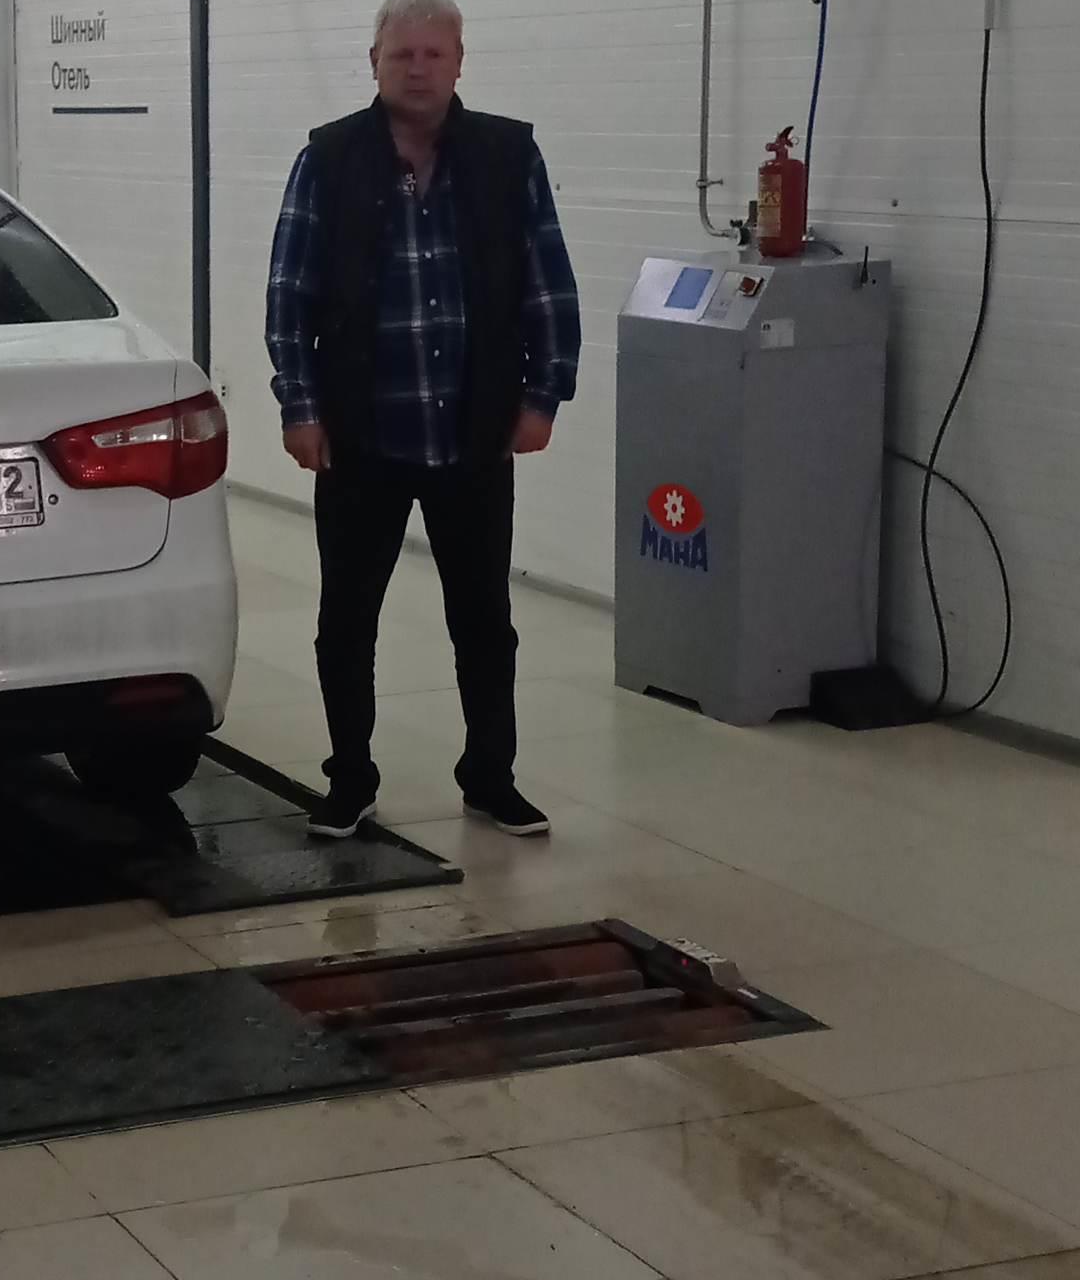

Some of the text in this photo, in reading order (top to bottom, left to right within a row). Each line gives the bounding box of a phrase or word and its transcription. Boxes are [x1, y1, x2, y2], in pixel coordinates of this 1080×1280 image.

[50, 9, 108, 44] Шинный
[50, 61, 91, 91] Отель
[639, 513, 709, 572] MAHA
